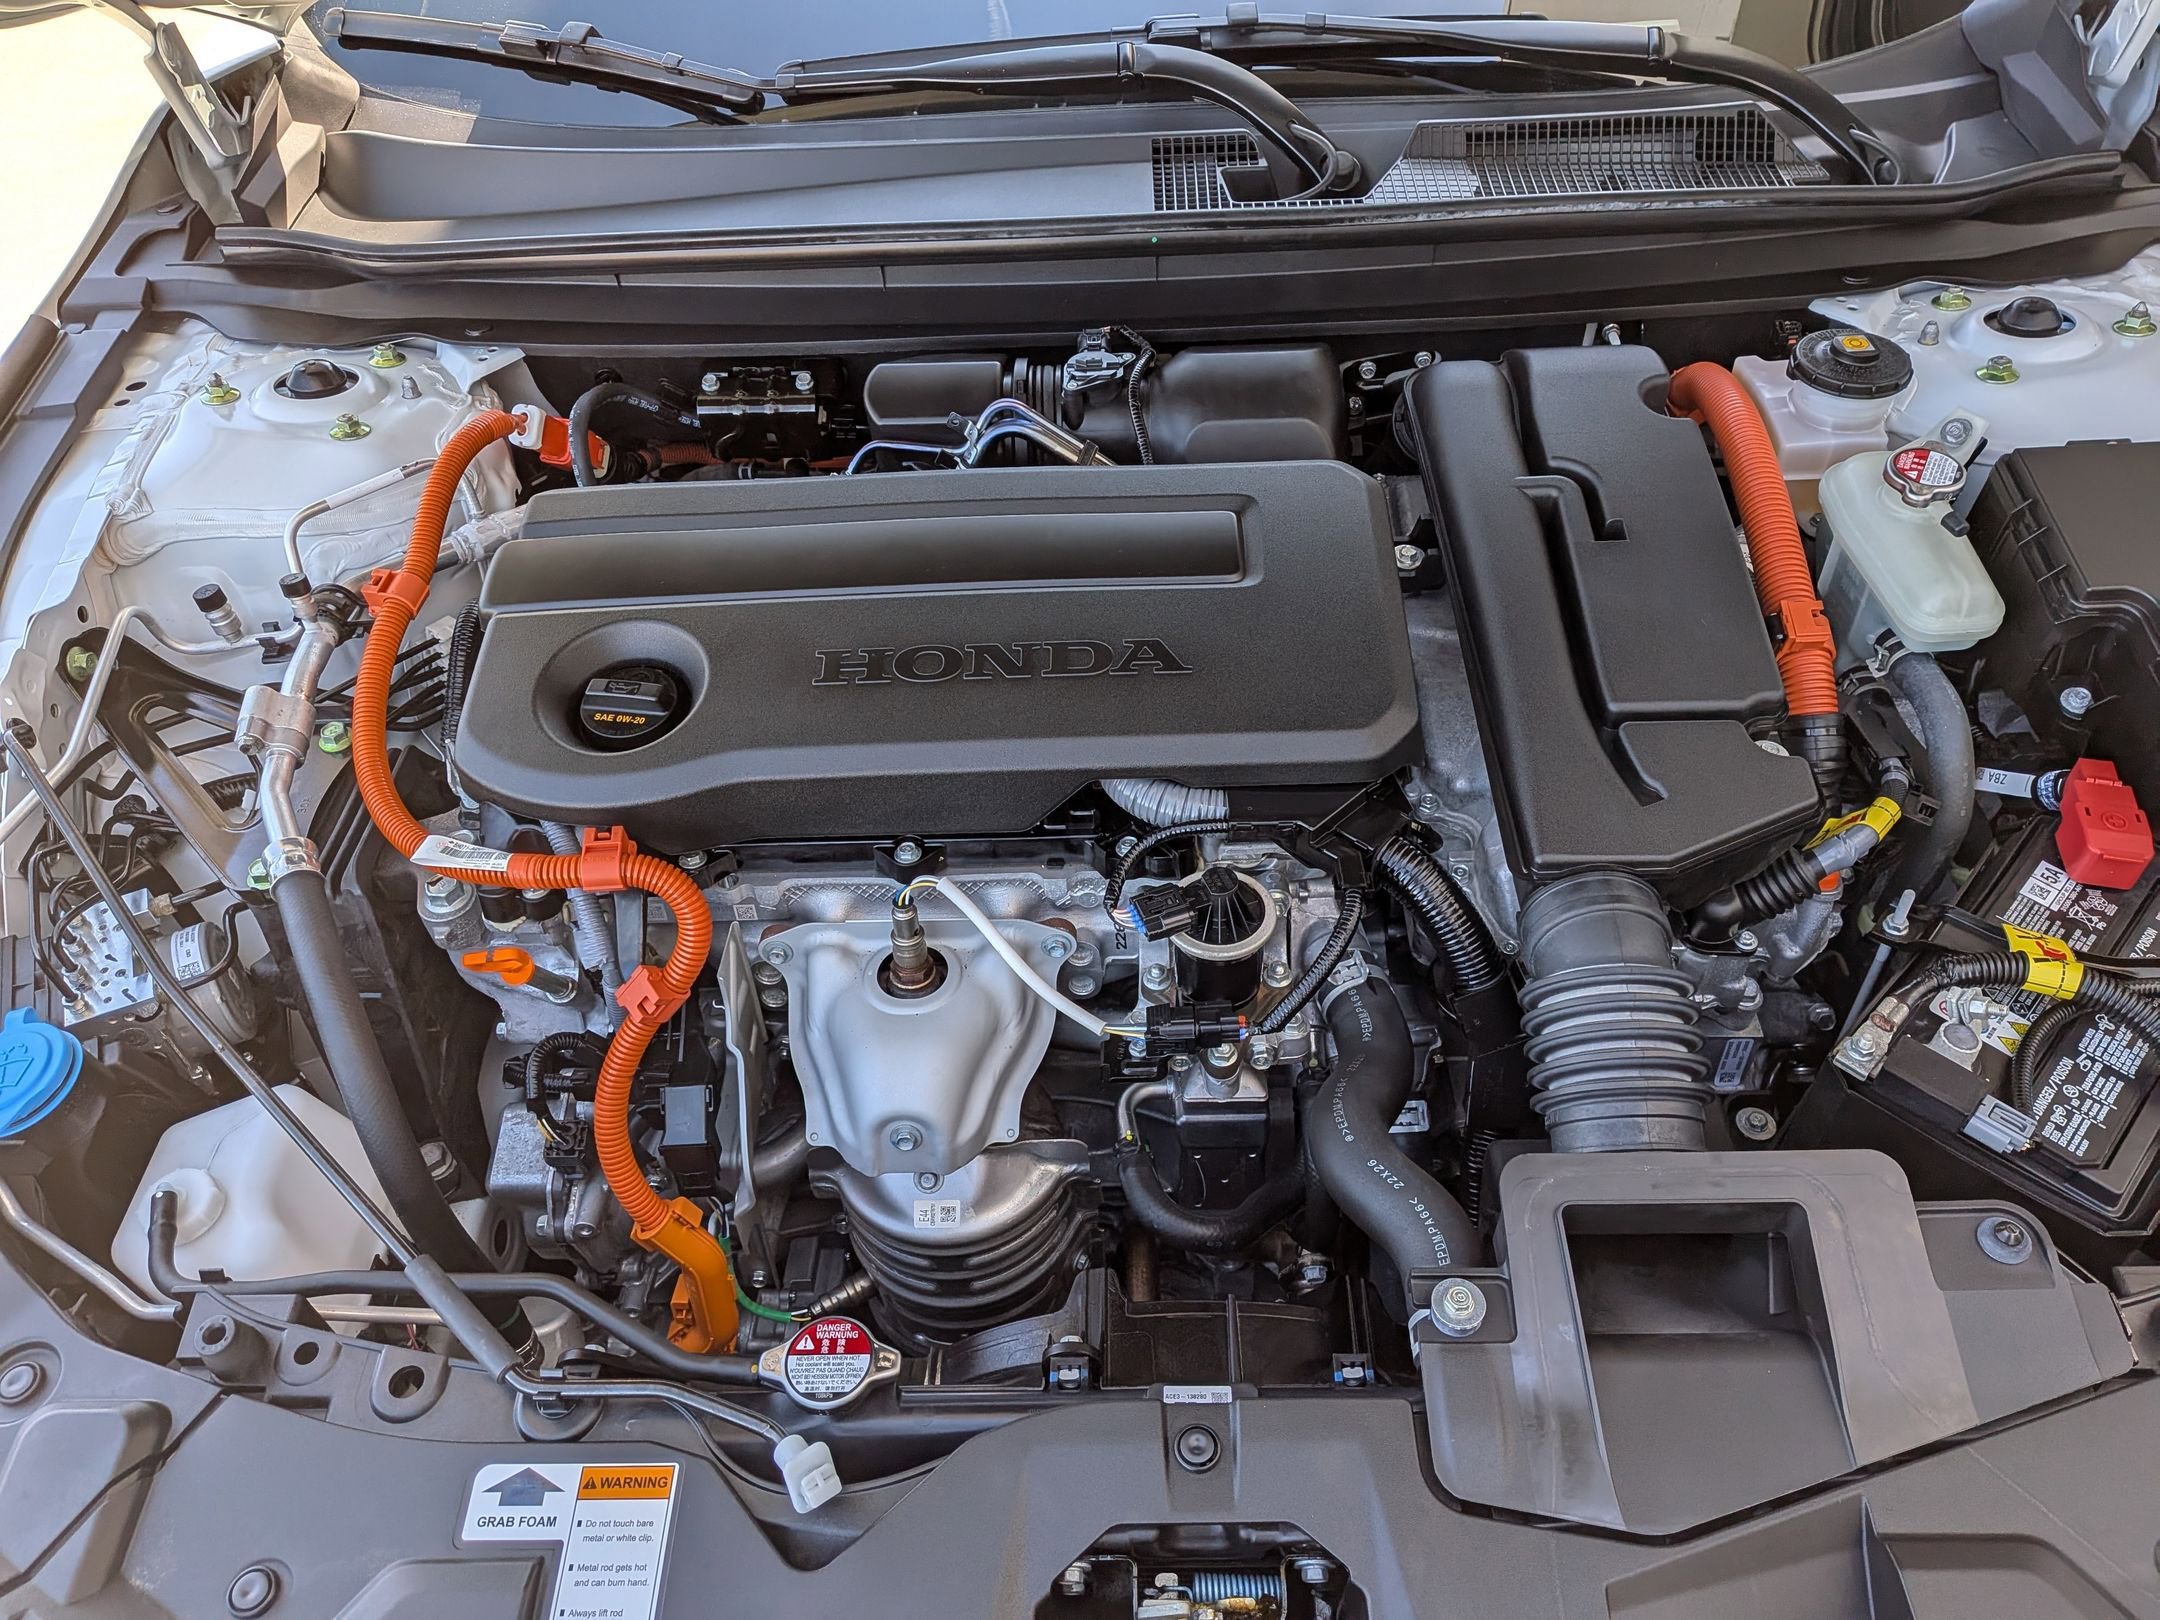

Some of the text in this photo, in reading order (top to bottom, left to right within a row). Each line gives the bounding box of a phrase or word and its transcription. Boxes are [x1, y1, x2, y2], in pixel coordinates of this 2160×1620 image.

[812, 638, 1192, 686] HONDA
[594, 713, 645, 724] SAE 0W-20
[1988, 772, 2007, 785] ZBA
[2041, 867, 2064, 884] 5A
[1367, 1159, 1405, 1189] 22X26
[918, 1209, 929, 1221] E44
[816, 1331, 858, 1339] WARNUNG
[600, 1476, 669, 1490] WARNING
[477, 1516, 557, 1528] GRAB FOAM
[636, 1519, 654, 1527] bare
[582, 1534, 604, 1542] metal
[616, 1534, 636, 1542] white
[638, 1534, 654, 1544] clip.
[577, 1563, 647, 1573] Metal rod gets hot
[574, 1579, 589, 1587] and
[608, 1579, 625, 1587] burn
[627, 1579, 650, 1587] hand.
[568, 1609, 623, 1619] Always lift rod
